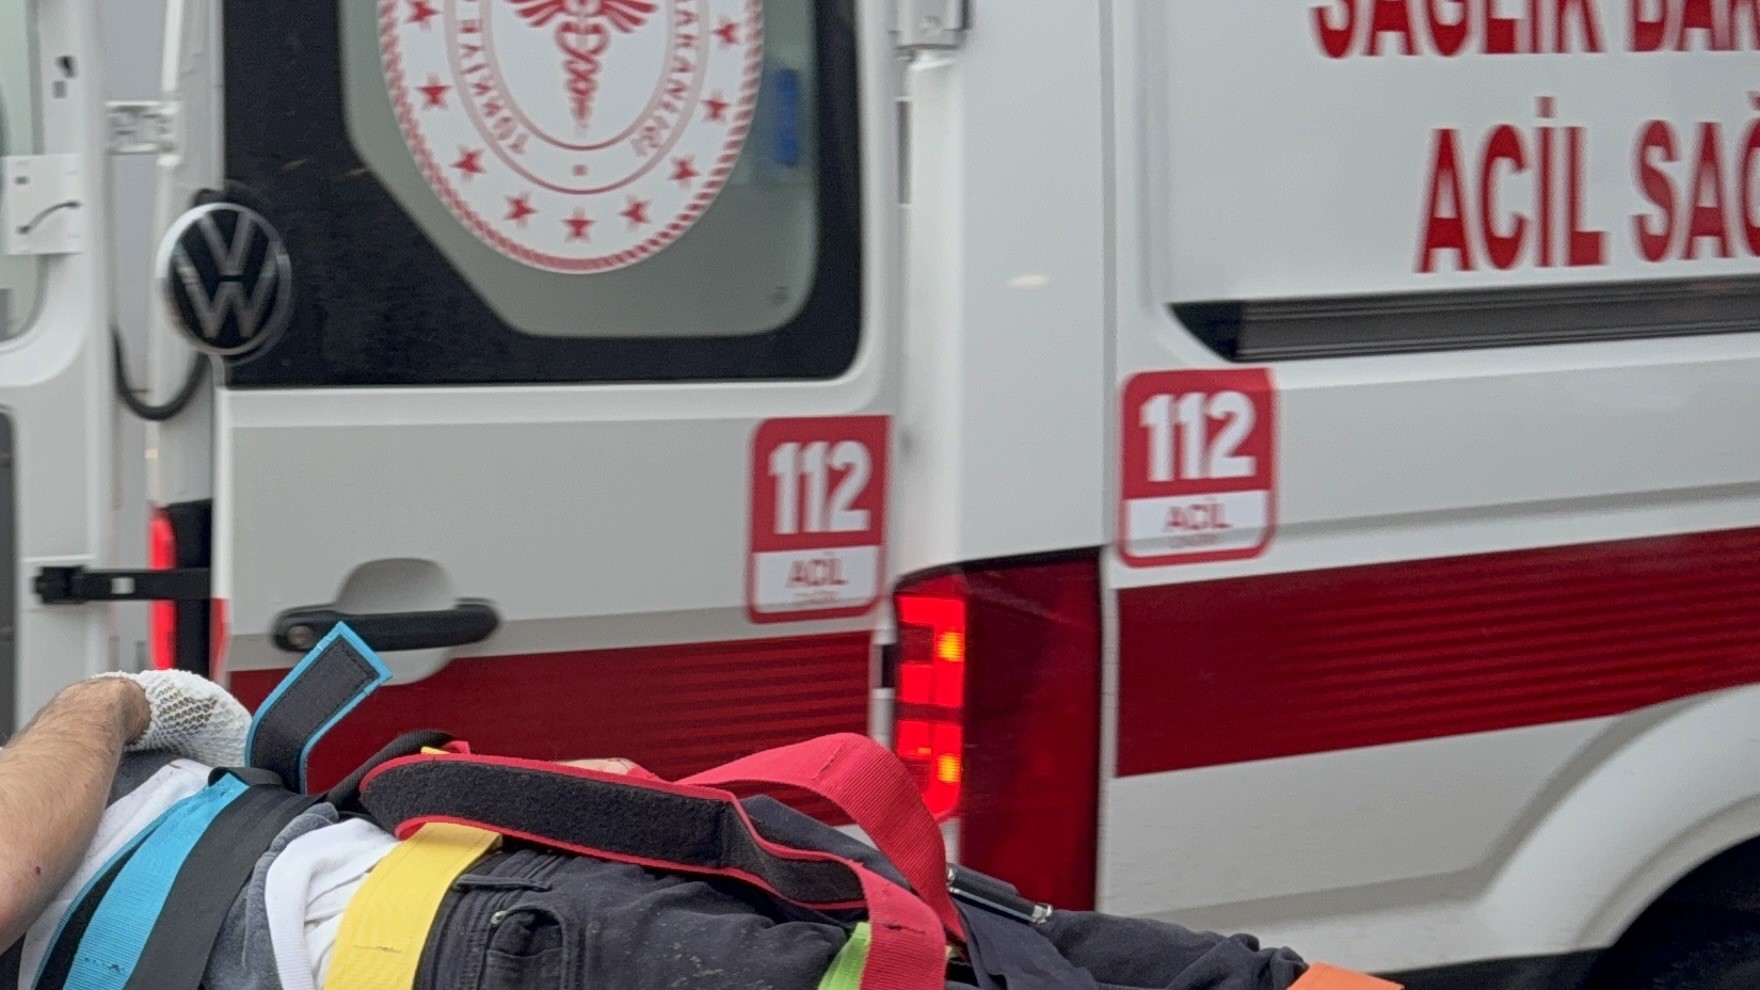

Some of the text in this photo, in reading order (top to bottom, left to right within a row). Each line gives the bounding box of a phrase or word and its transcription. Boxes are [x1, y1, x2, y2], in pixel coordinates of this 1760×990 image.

[1413, 96, 1610, 274] ACİL
[1139, 391, 1257, 483] 112
[769, 439, 873, 536] 112
